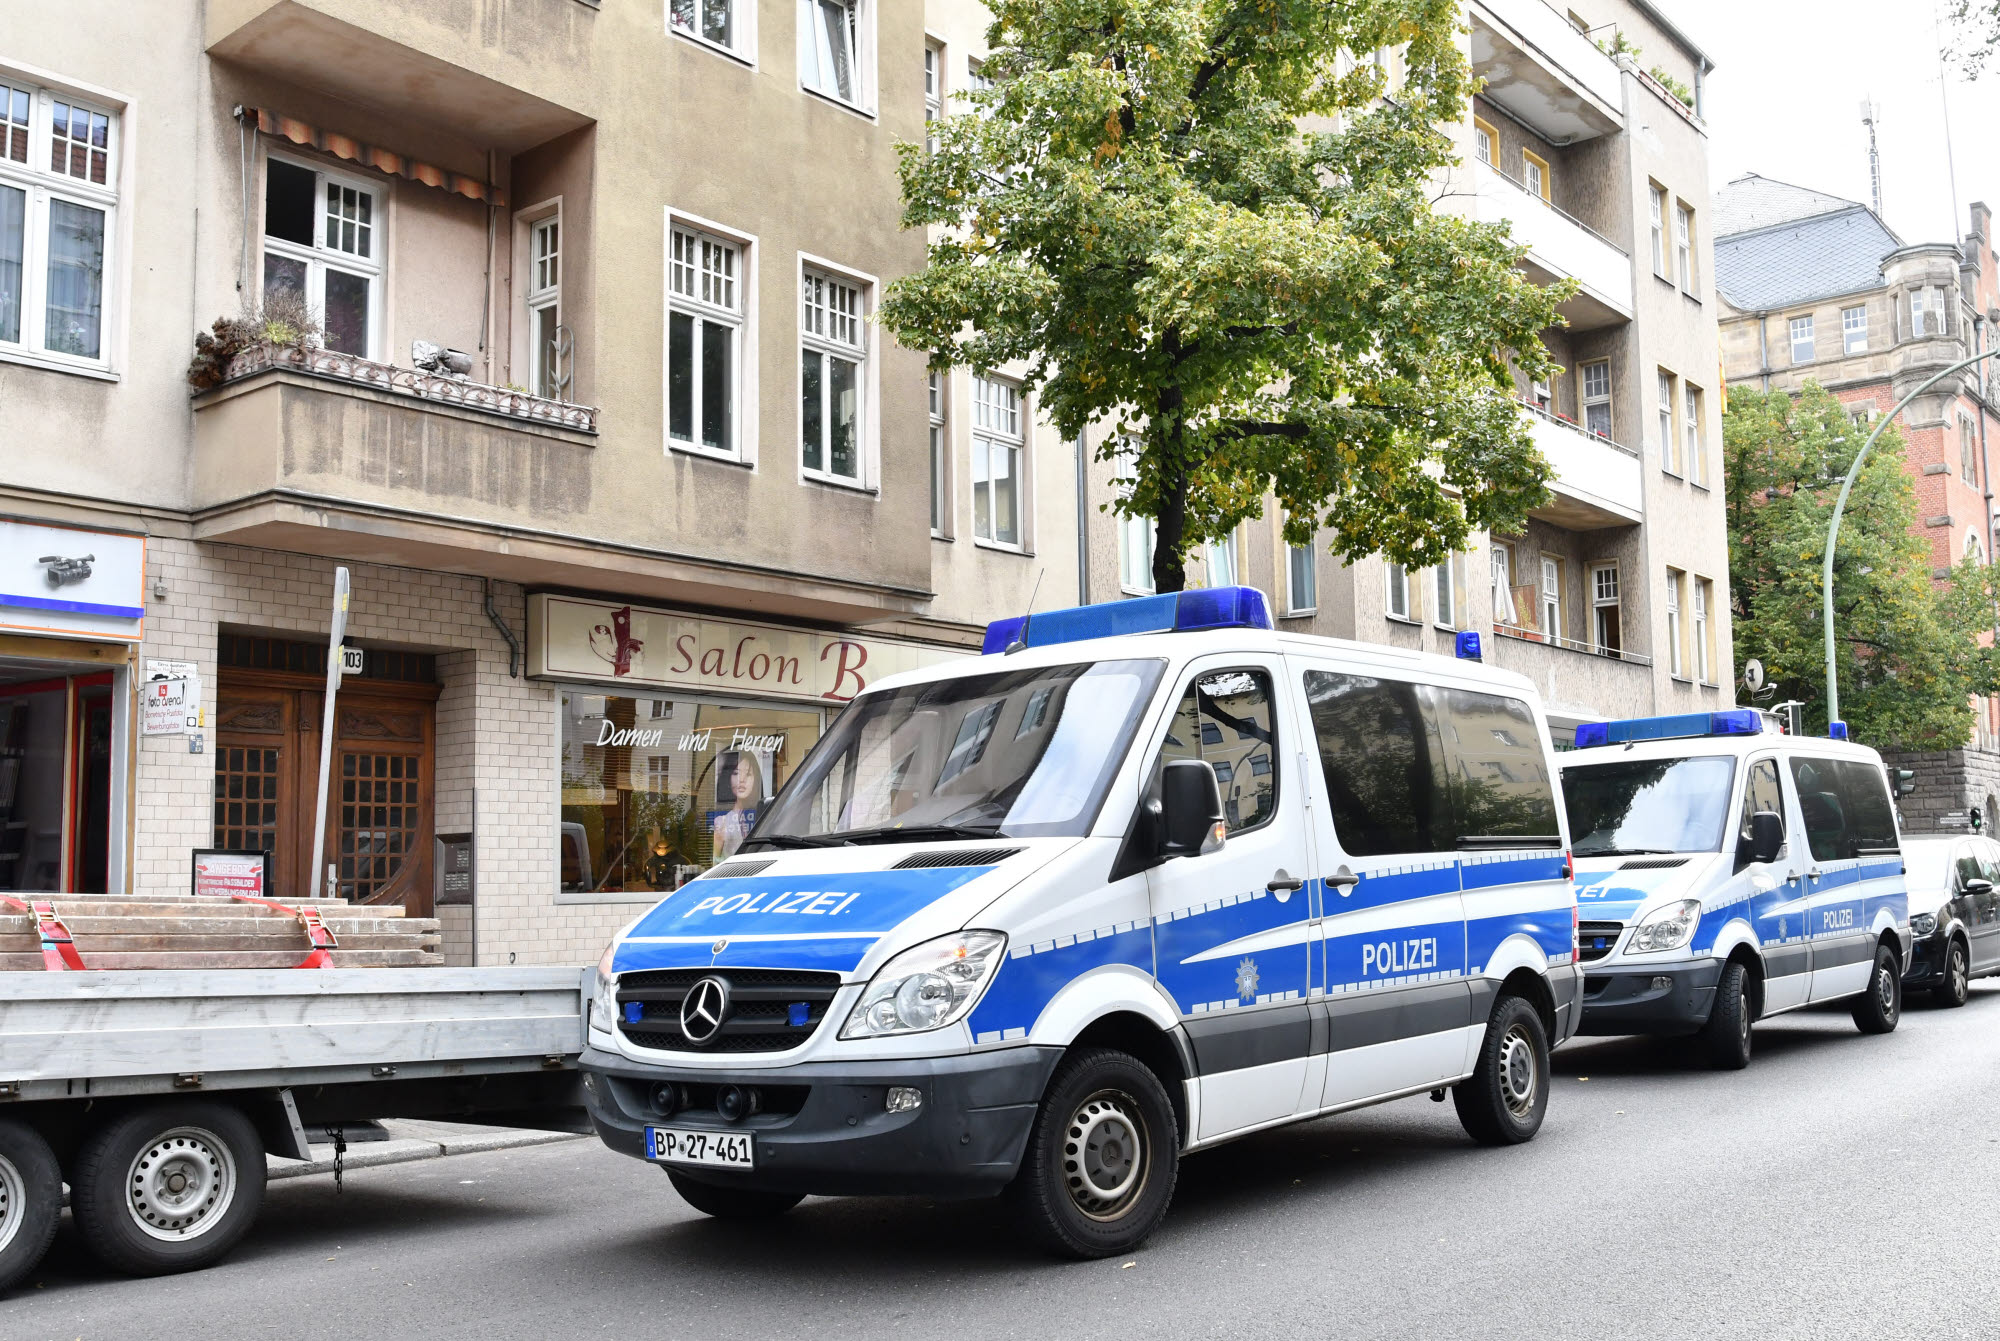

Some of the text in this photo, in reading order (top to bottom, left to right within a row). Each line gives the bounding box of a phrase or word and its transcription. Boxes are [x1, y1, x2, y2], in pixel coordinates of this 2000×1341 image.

[343, 651, 362, 668] 103
[671, 633, 803, 686] Salon
[148, 694, 181, 708] foto arena
[596, 719, 784, 753] Damen und Herren
[209, 863, 250, 875] ANGEBOT
[683, 891, 860, 918] POLIZEI
[1823, 909, 1853, 930] POLIZEI
[1362, 938, 1437, 976] POLIZEI
[649, 1145, 654, 1153] D
[655, 1131, 751, 1163] BP 27-461
